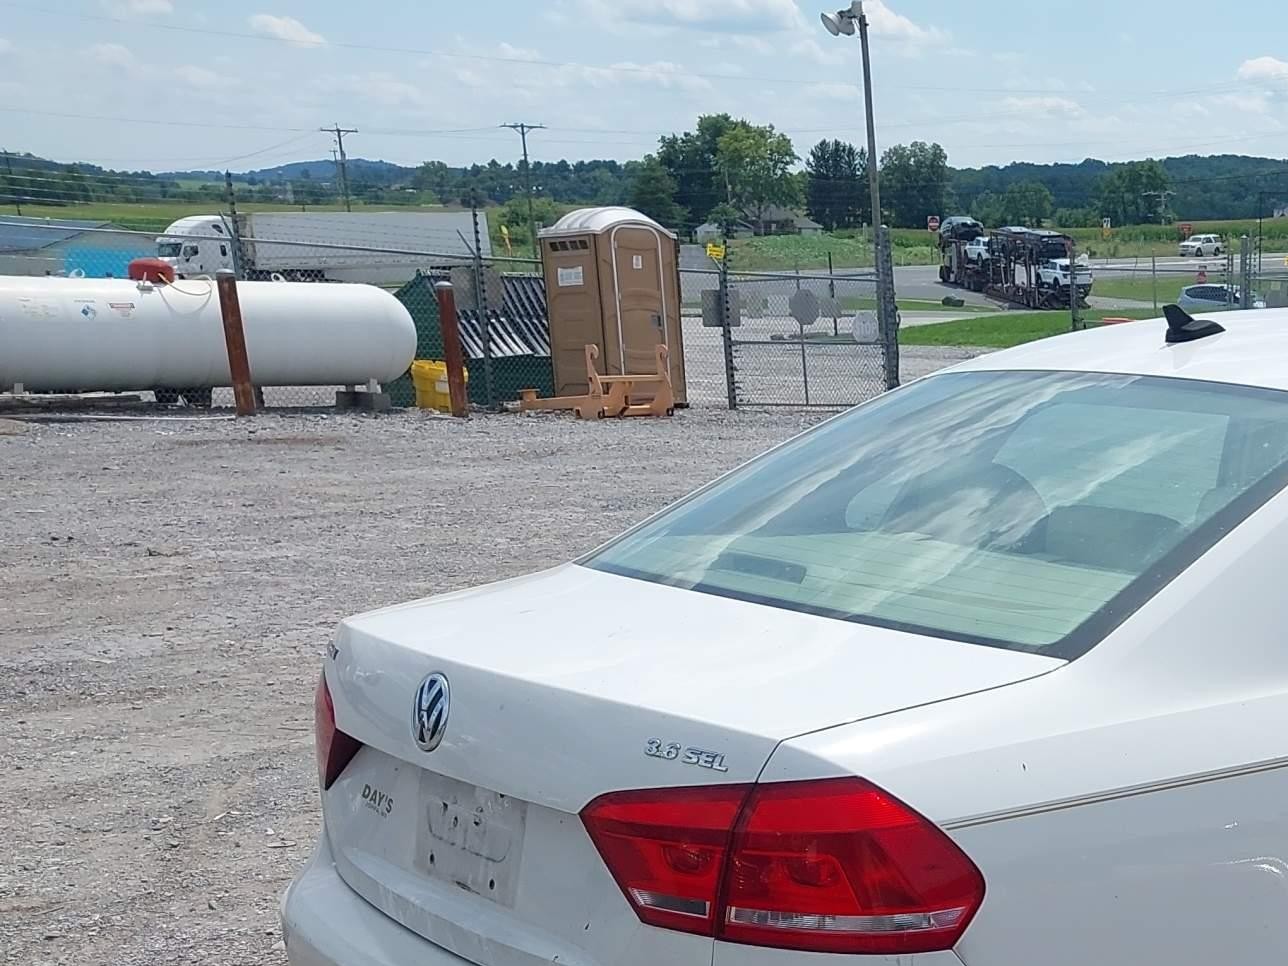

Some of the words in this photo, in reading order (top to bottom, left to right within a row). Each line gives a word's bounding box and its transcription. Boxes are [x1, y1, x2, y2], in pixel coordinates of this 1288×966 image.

[644, 737, 681, 760] 3.6
[681, 746, 729, 773] SEL
[361, 783, 394, 814] DAY'S
